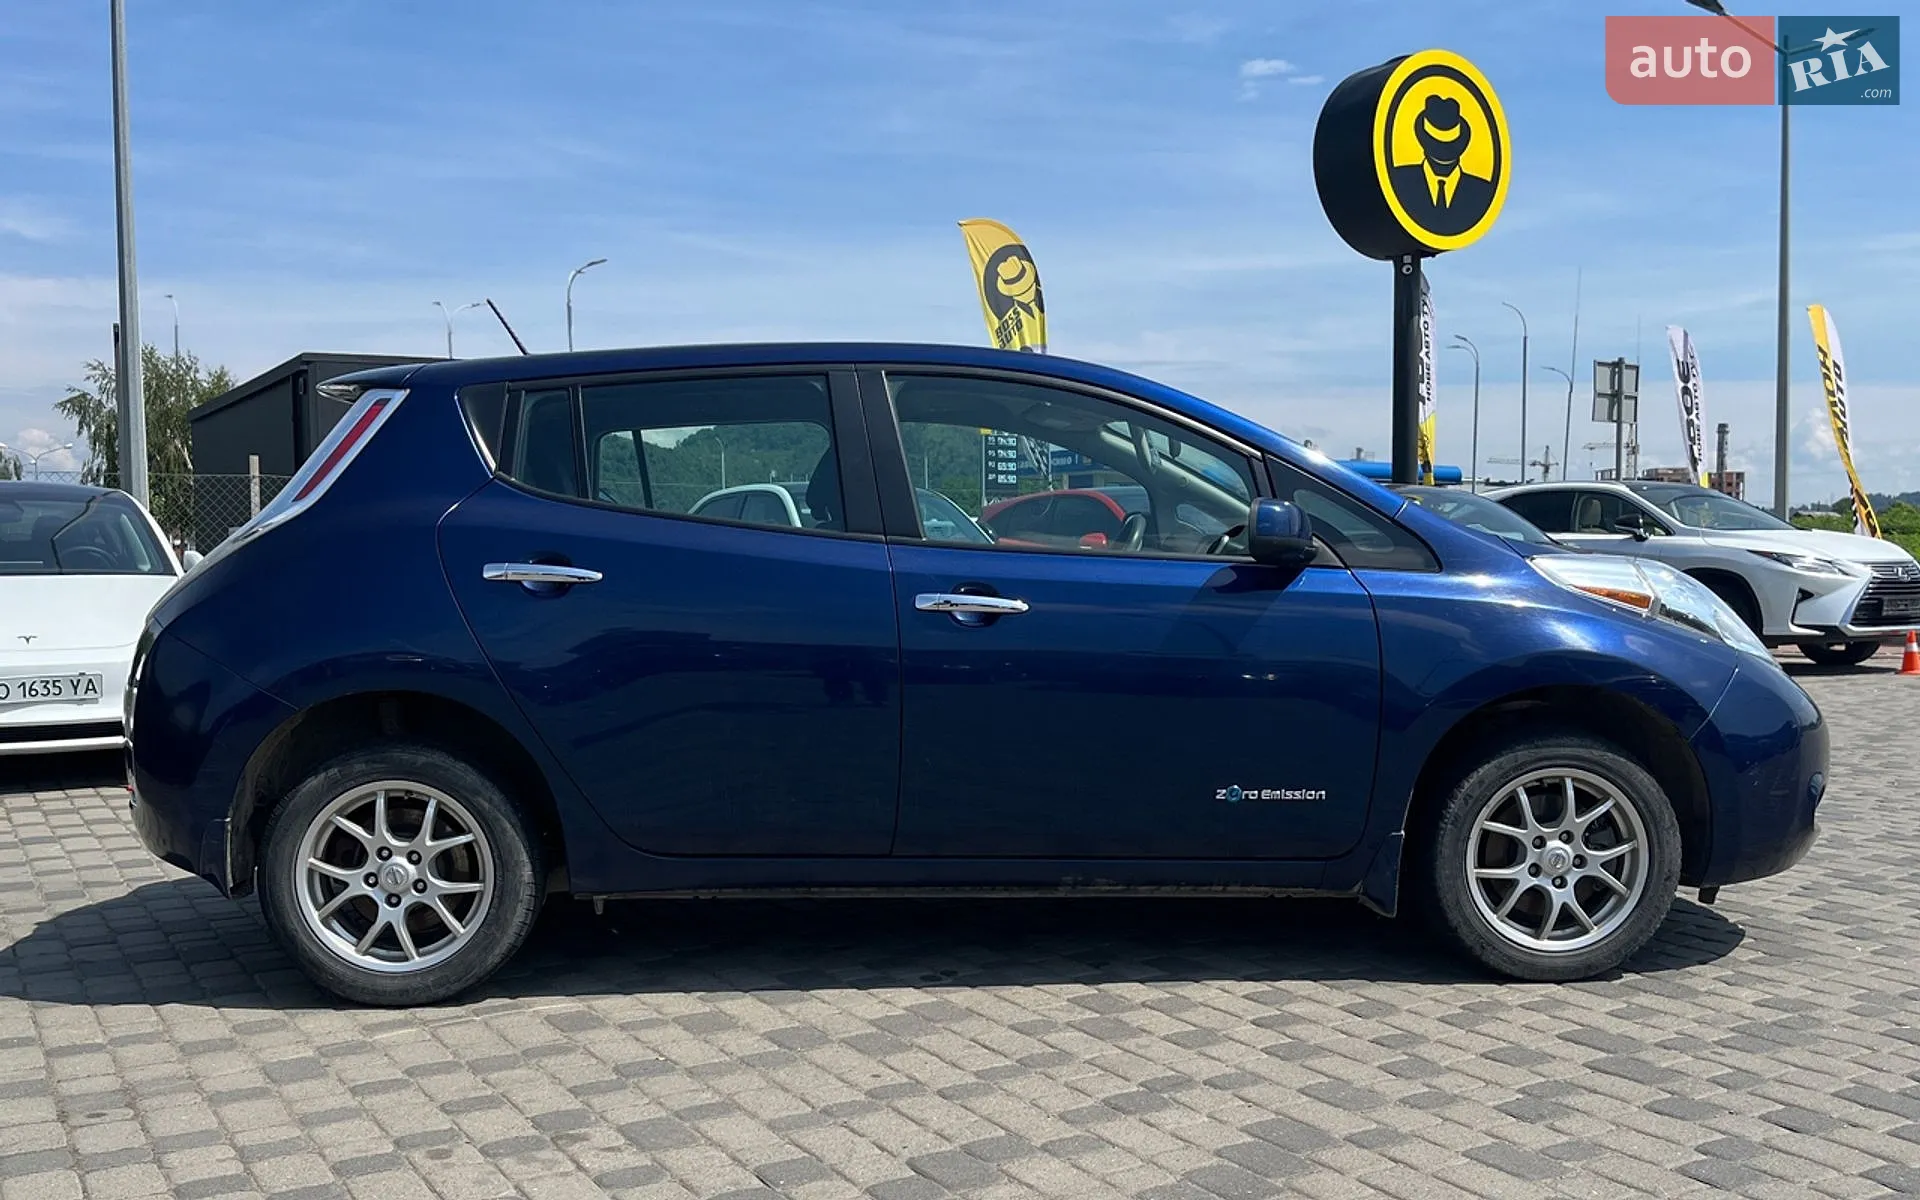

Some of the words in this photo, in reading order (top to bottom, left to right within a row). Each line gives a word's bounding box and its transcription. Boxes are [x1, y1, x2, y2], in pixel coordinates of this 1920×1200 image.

[995, 307, 1021, 339] BOSS
[18, 679, 63, 698] 1635
[70, 678, 98, 696] YA
[1261, 789, 1326, 800] Emission
